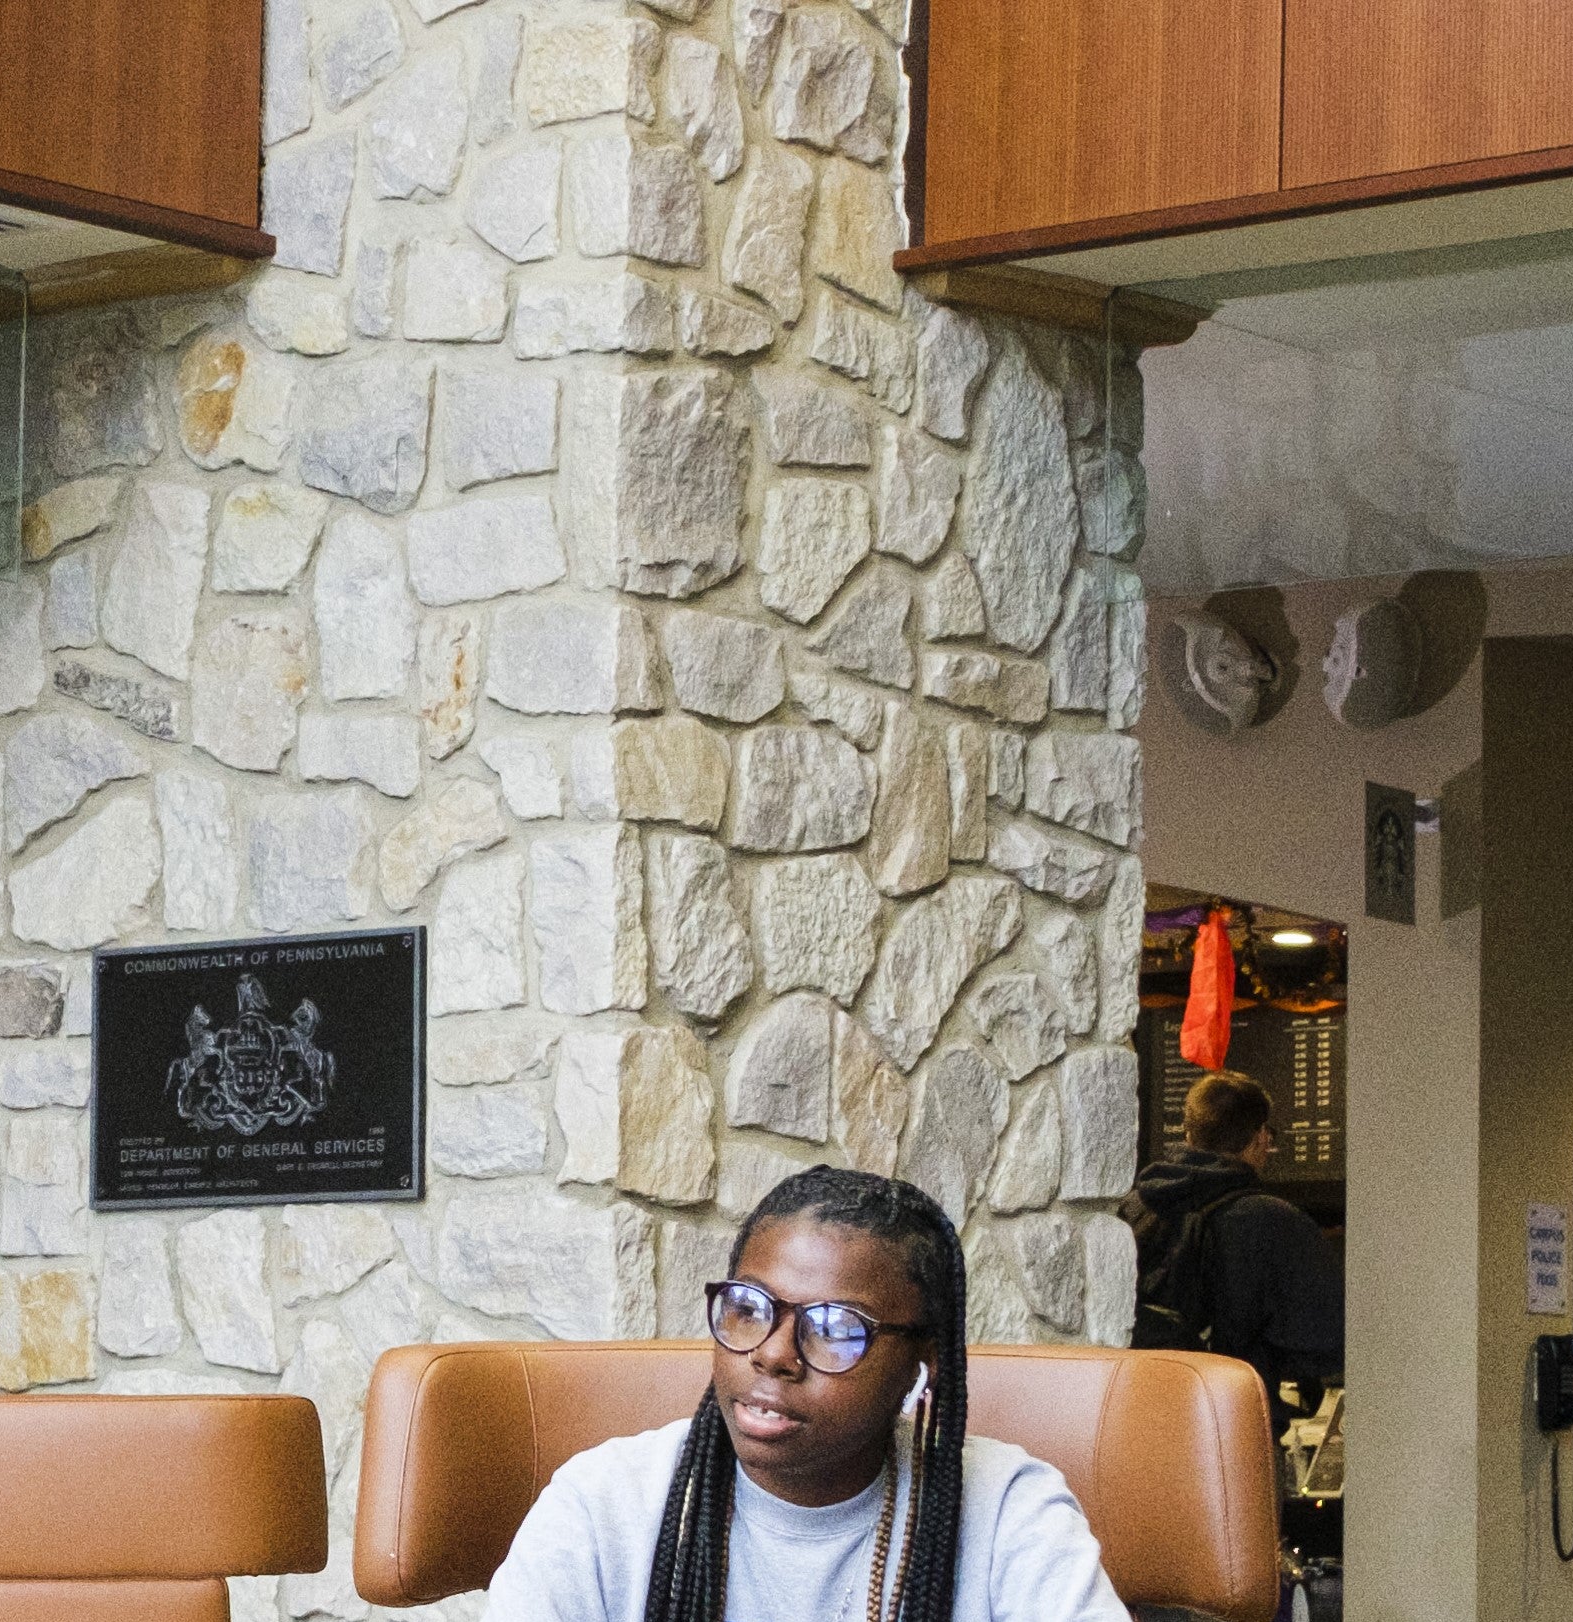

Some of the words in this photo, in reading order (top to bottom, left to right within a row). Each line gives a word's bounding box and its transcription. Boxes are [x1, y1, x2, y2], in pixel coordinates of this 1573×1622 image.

[124, 955, 243, 974] COMMONWEALTH
[250, 951, 269, 965] OF
[276, 945, 385, 963] PENNSYLVANIA
[120, 1147, 211, 1163] DEPARTMENT
[217, 1145, 234, 1159] OF
[242, 1142, 307, 1158] GENERAL
[314, 1138, 385, 1155] SERVICES
